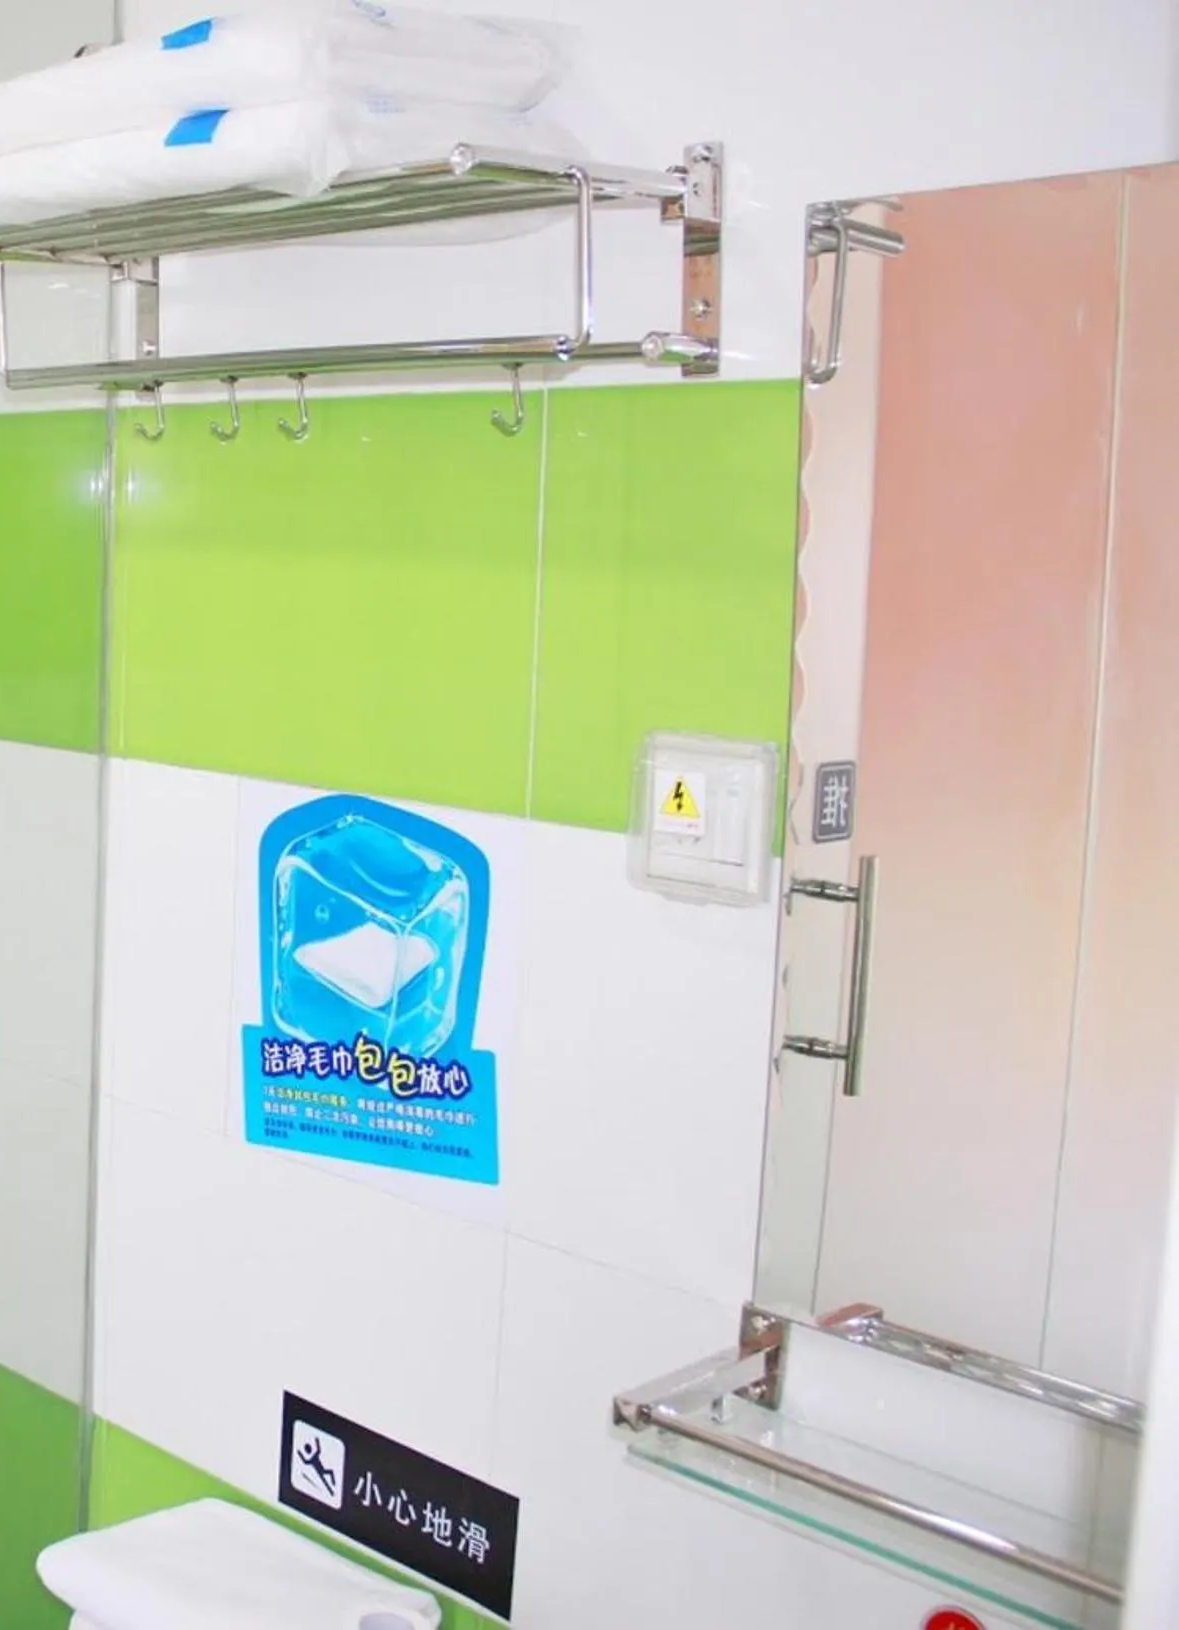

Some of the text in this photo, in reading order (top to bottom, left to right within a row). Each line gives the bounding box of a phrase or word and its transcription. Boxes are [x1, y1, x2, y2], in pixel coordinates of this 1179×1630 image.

[263, 1033, 470, 1098] 洁净毛巾包包放心
[354, 1471, 491, 1565] 小心地滑
